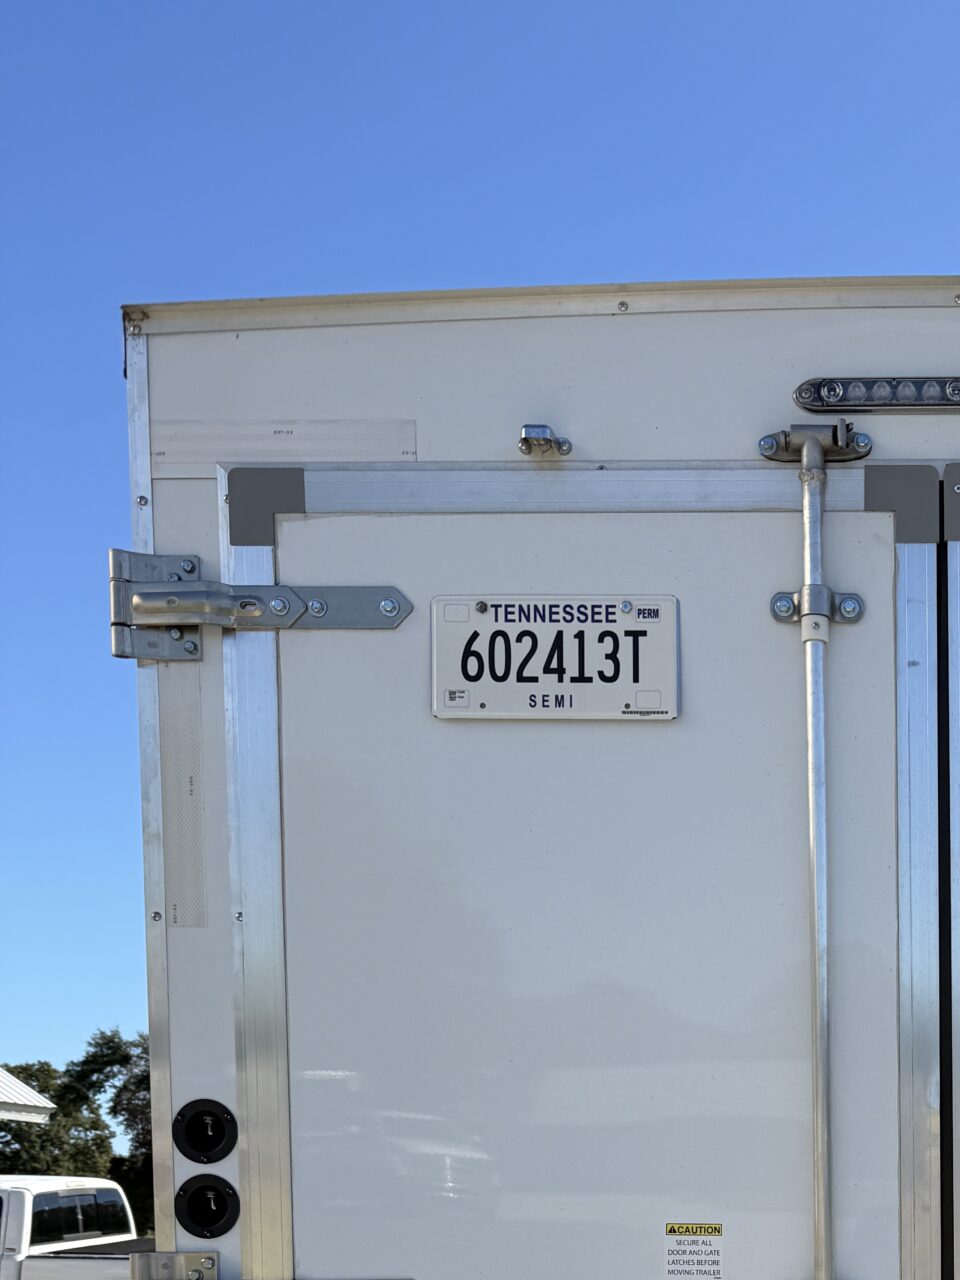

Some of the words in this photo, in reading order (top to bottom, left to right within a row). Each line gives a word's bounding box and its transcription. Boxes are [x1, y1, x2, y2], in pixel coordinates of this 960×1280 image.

[490, 604, 617, 624] TENNESSEE
[637, 608, 660, 619] PERM
[460, 629, 648, 684] 602413T
[528, 694, 574, 709] SEMI
[677, 1226, 720, 1234] CAUTION
